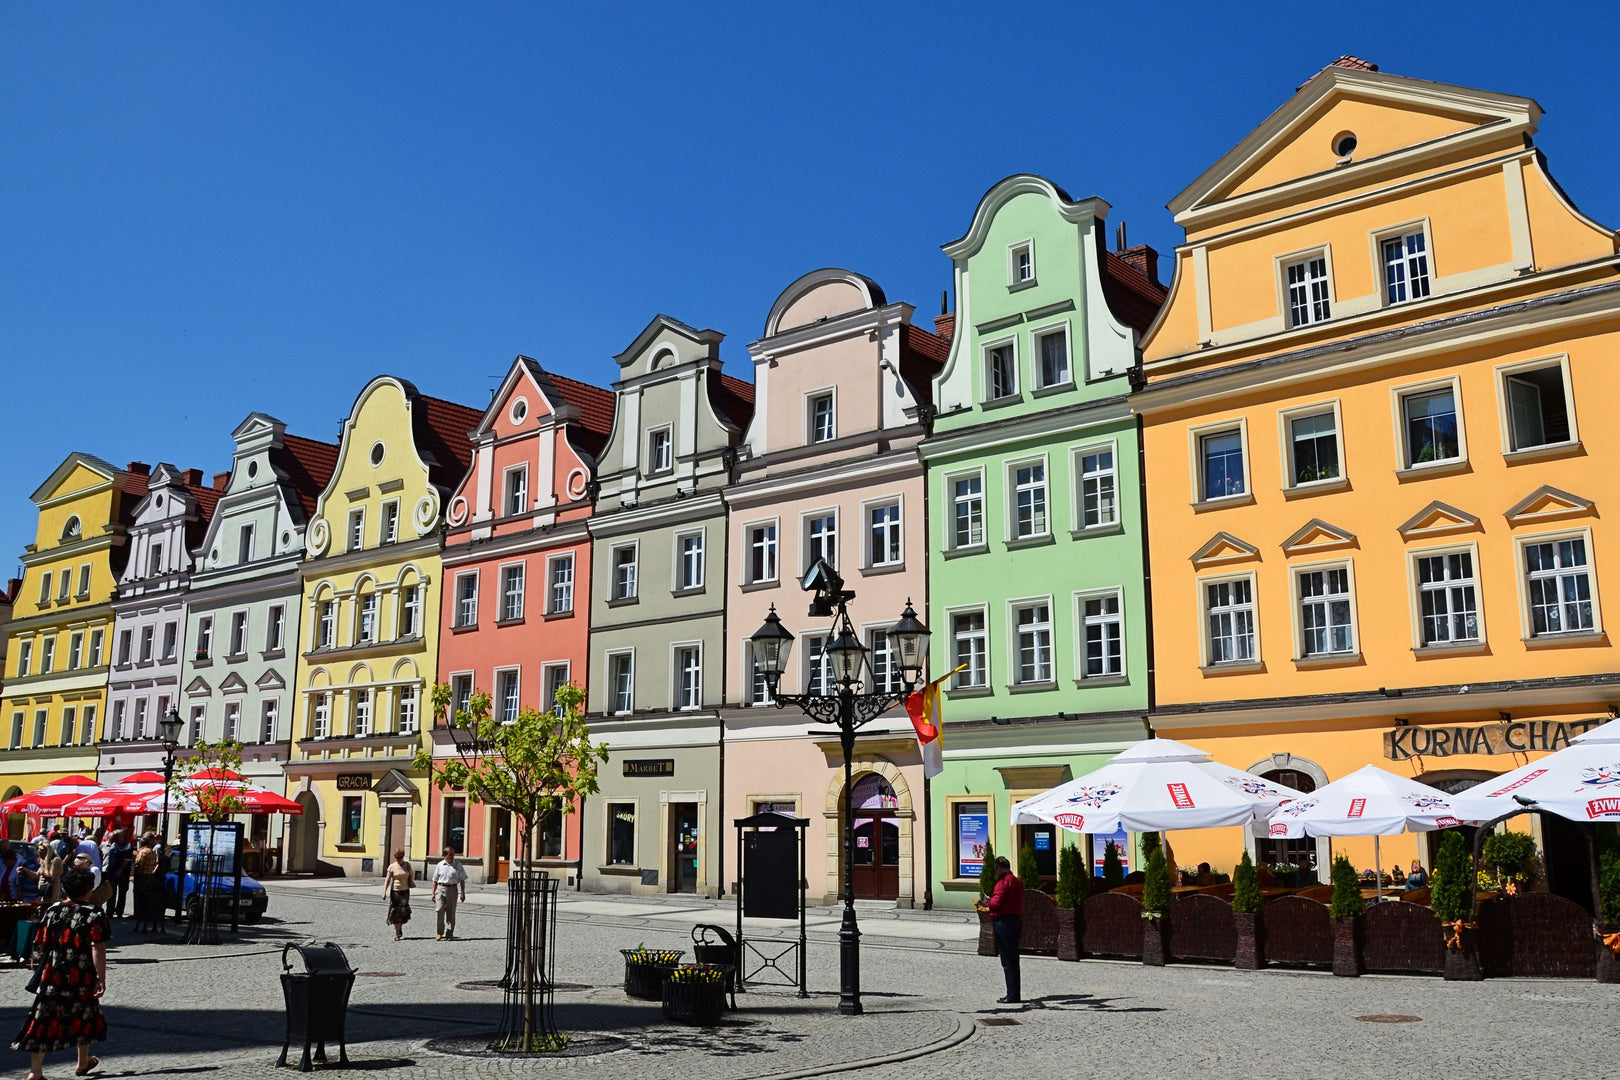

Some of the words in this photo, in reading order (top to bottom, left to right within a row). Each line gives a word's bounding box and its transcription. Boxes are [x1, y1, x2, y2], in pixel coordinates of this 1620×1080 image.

[1391, 727, 1494, 758] KURNA
[1505, 718, 1613, 750] CHAT
[339, 776, 369, 788] GRACIA
